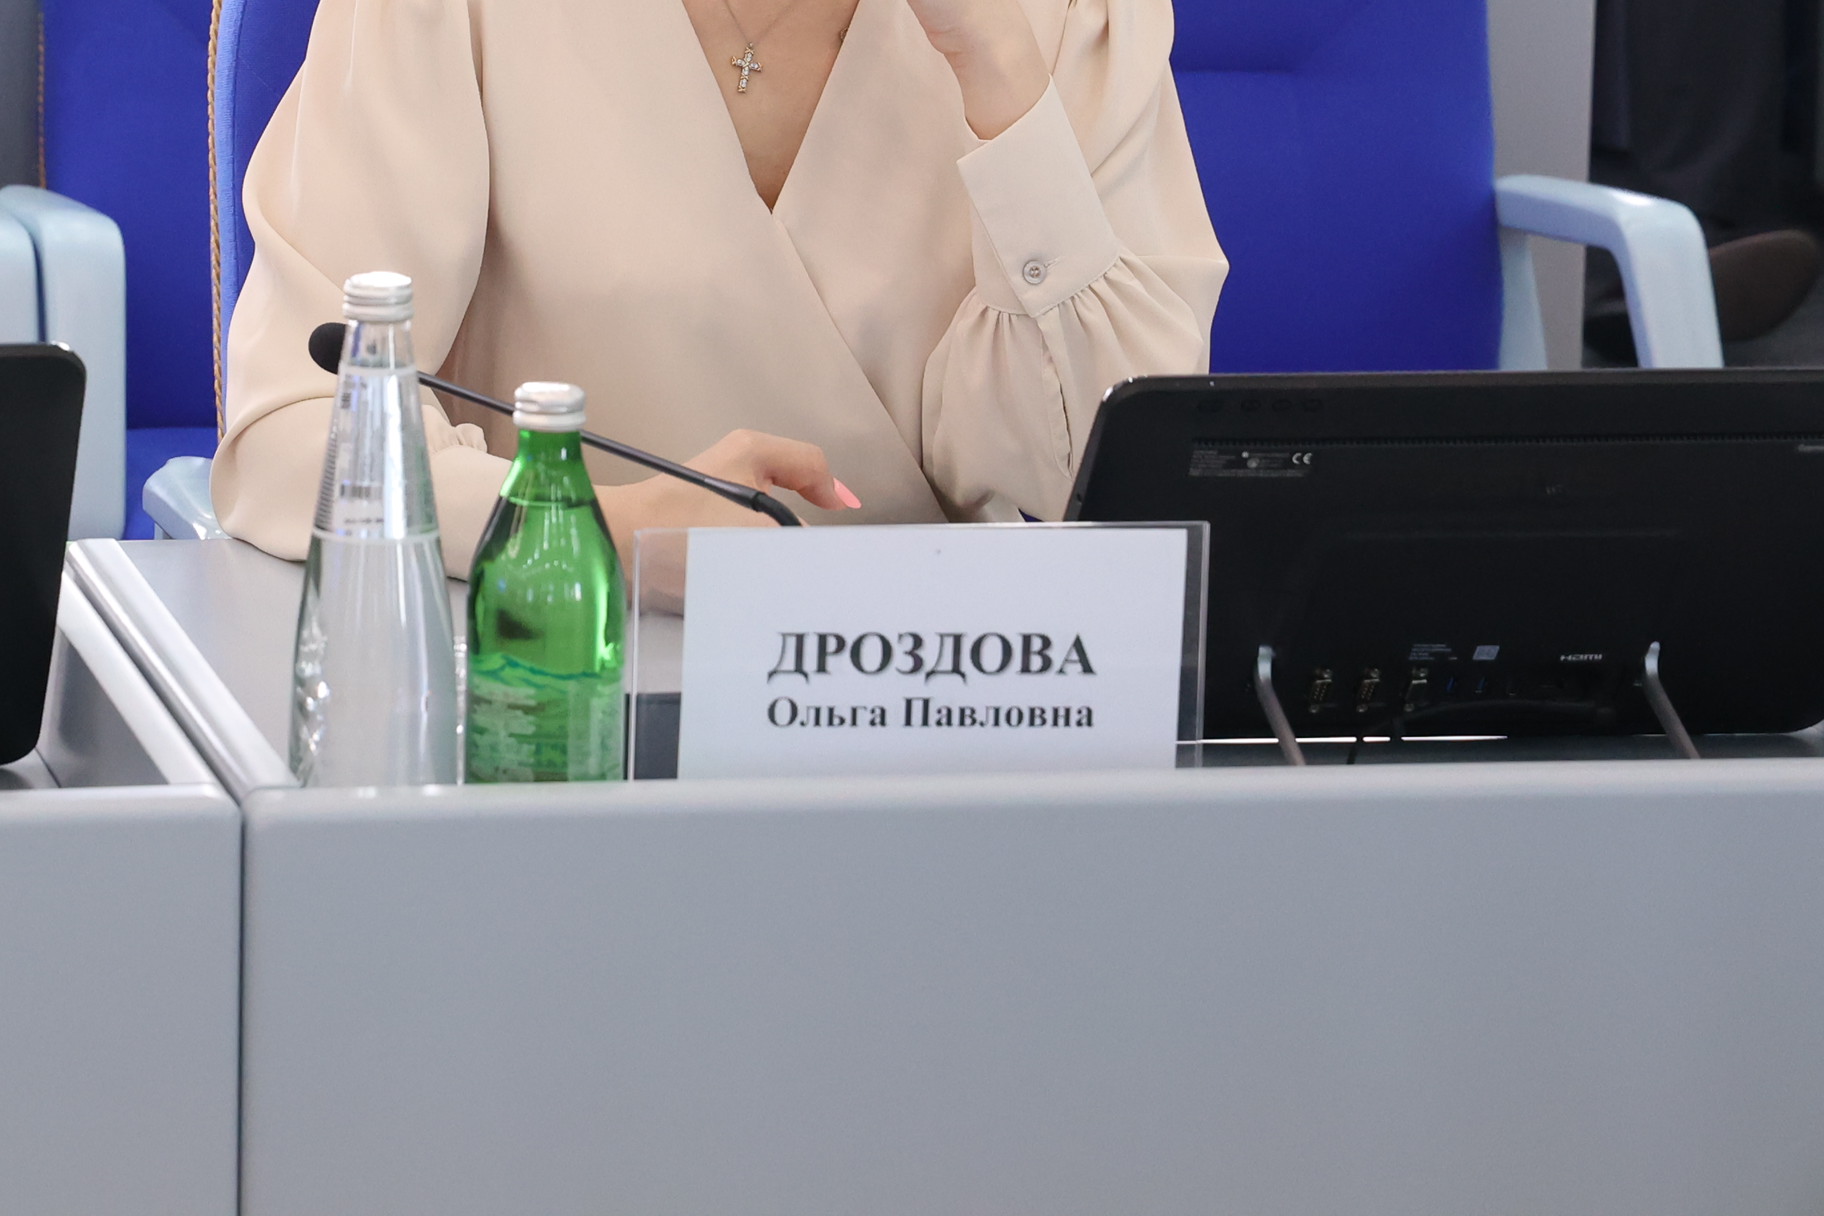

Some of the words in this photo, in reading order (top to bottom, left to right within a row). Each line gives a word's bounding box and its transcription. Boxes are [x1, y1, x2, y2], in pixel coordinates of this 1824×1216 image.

[767, 632, 1097, 684] ДРОЗДОВА
[767, 698, 887, 728] Ольга
[903, 697, 1094, 728] Павловна
